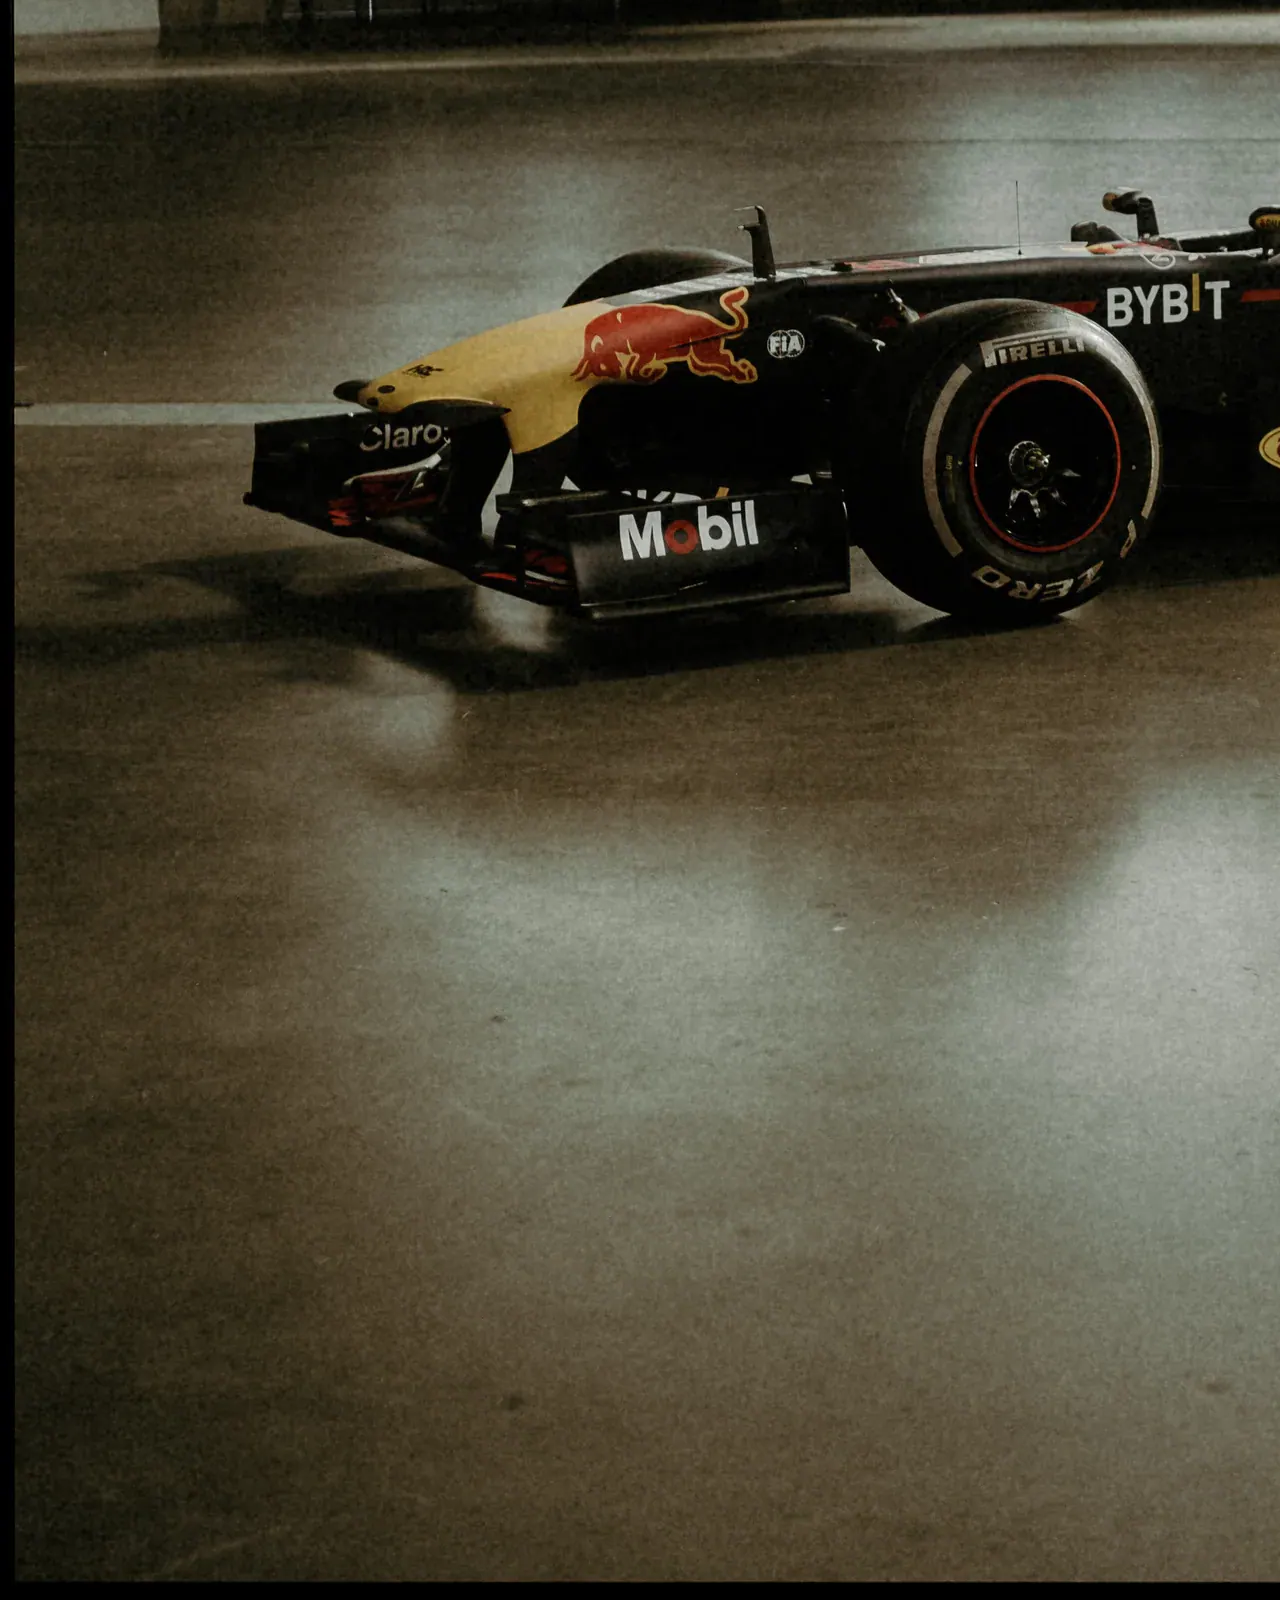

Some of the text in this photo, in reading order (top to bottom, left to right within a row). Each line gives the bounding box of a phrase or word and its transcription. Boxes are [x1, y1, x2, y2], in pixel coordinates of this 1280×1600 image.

[1106, 272, 1231, 328] BYBIT
[979, 328, 1087, 368] PIRELLI
[359, 422, 443, 452] Claro
[618, 499, 760, 561] Mobil
